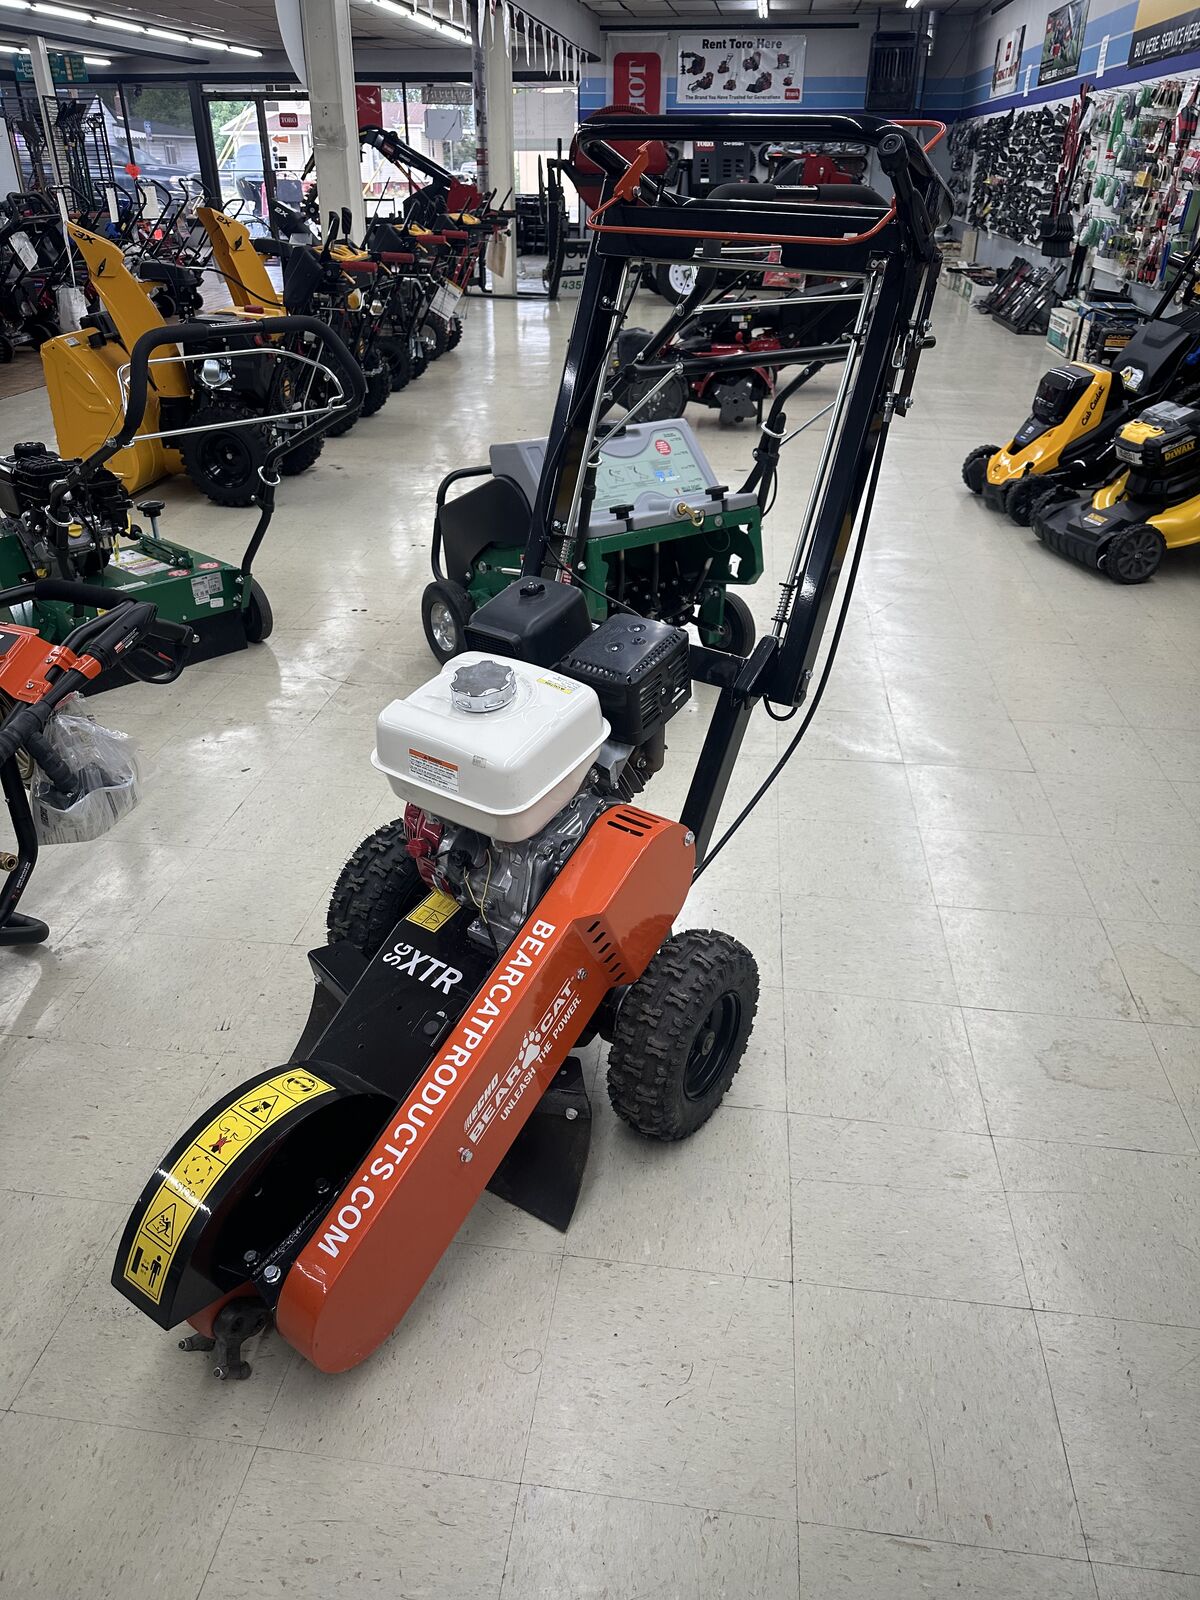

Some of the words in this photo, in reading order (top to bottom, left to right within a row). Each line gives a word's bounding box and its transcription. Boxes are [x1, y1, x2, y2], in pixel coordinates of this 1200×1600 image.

[702, 38, 726, 49] Rent
[729, 38, 753, 49] Toro
[757, 38, 782, 49] Here
[1134, 40, 1147, 58] BUY
[1161, 26, 1185, 50] SERVICE
[73, 230, 97, 245] 3X
[216, 215, 231, 227] 2X
[1081, 411, 1092, 426] Cub
[1090, 385, 1105, 410] Cadet
[396, 949, 463, 995] XTR
[468, 1064, 521, 1143] BEAR
[540, 980, 573, 1033] CAT
[500, 1067, 537, 1121] UNLEASH
[535, 1040, 553, 1064] THE
[317, 919, 556, 1259] BEARCATPRODUCTS.COM
[471, 1073, 499, 1121] ECHO
